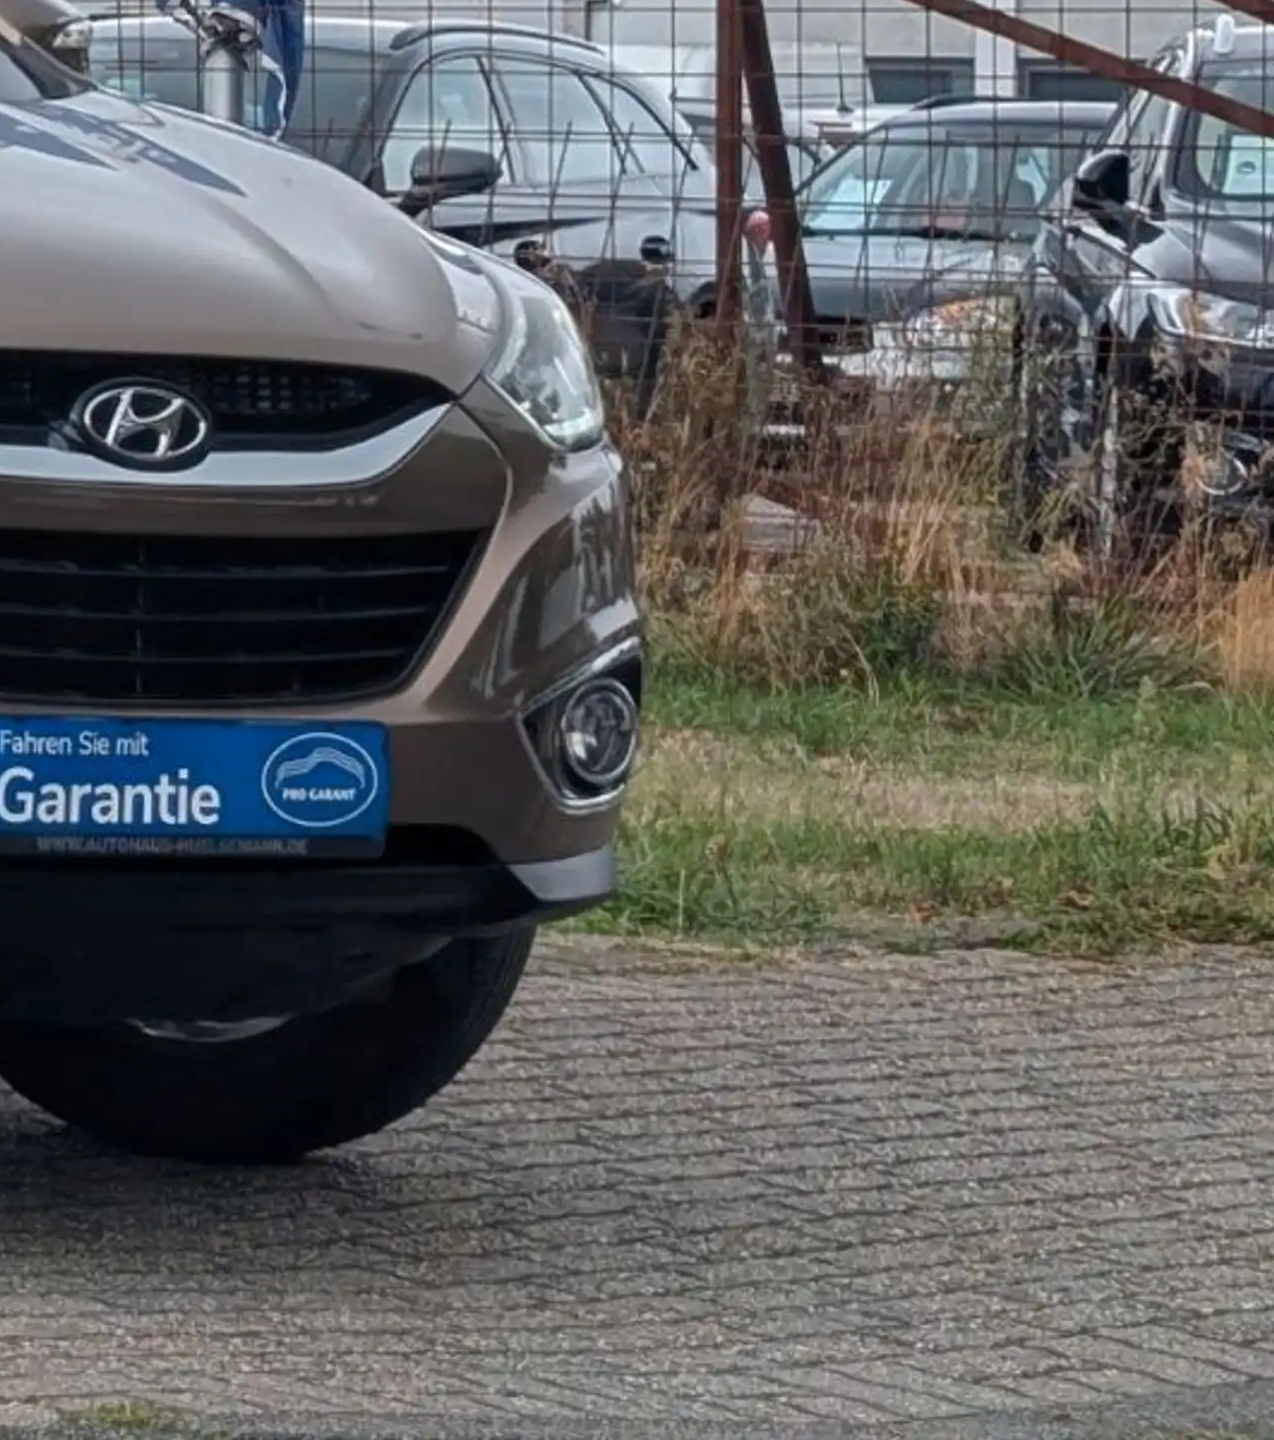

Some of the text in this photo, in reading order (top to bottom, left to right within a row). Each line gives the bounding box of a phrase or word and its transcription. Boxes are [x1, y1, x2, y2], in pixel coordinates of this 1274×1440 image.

[0, 729, 150, 757] Fahren Sie mit
